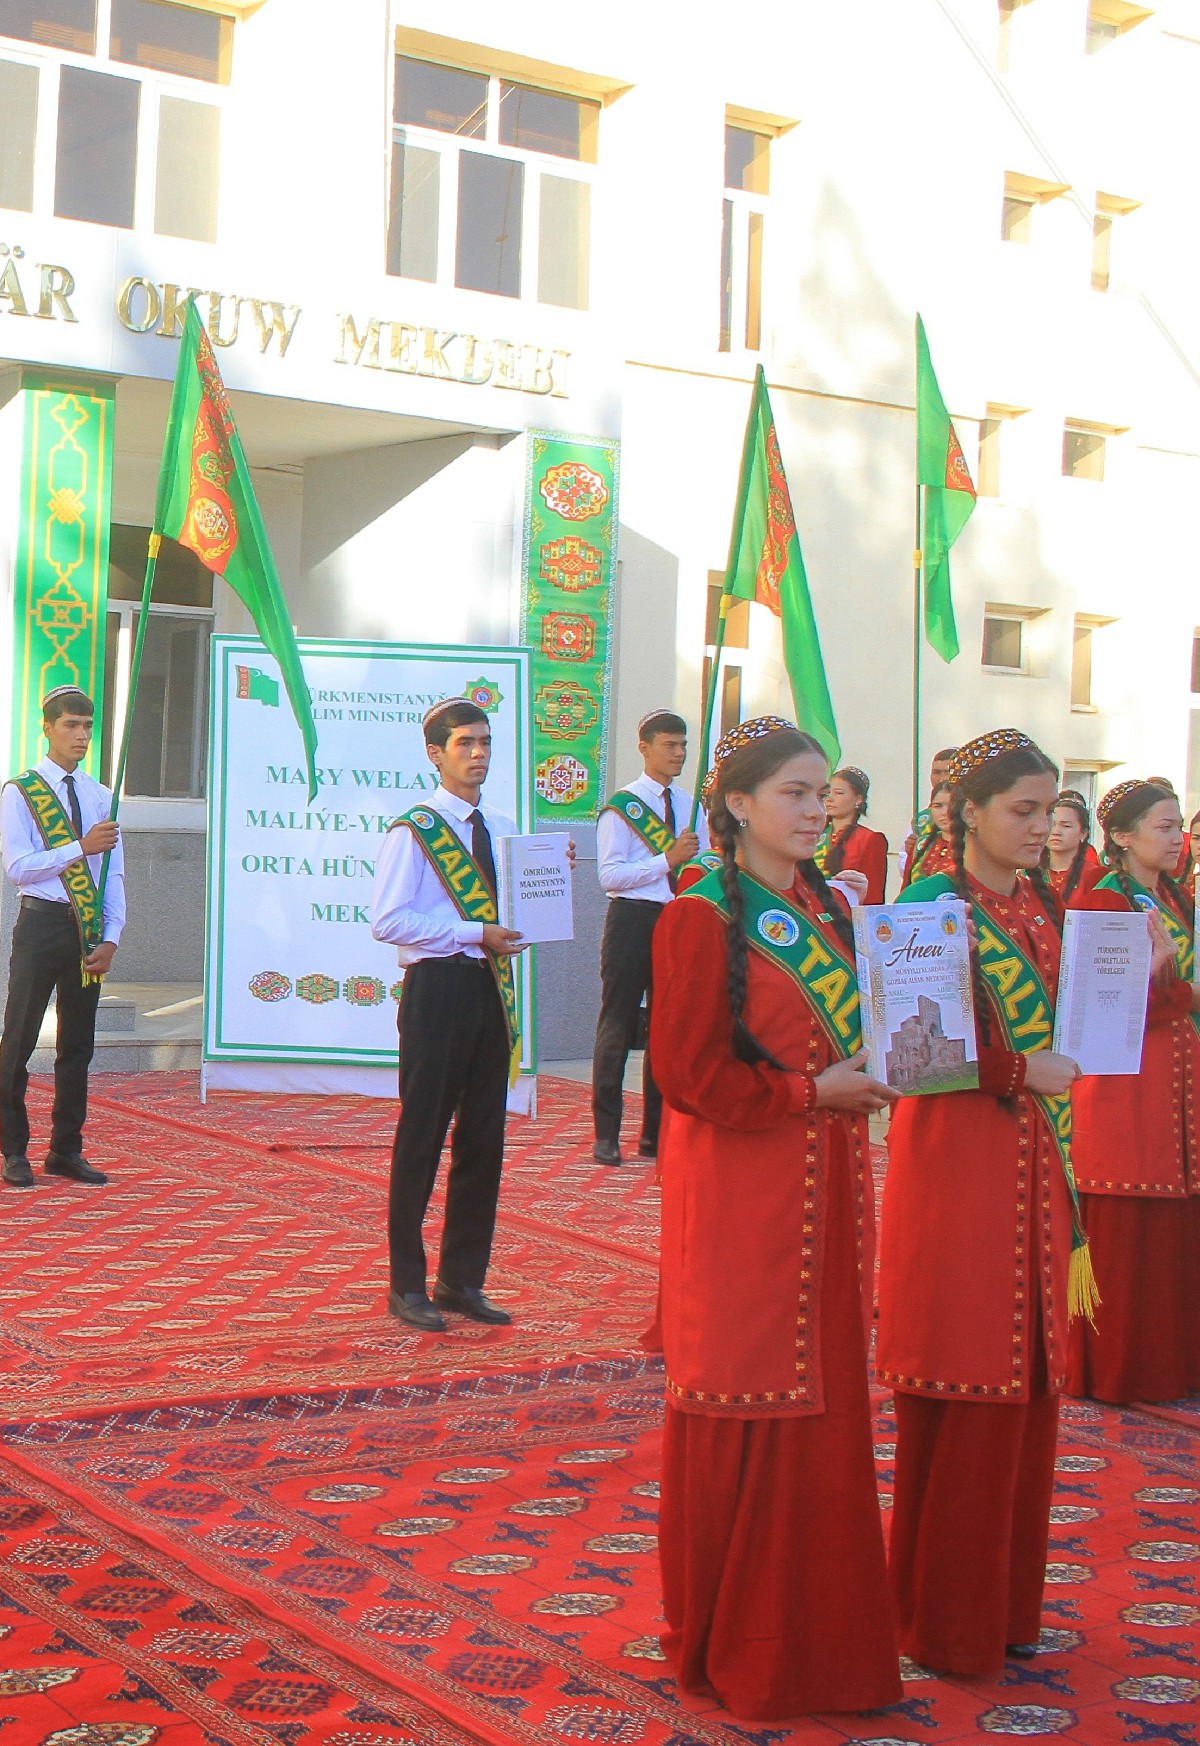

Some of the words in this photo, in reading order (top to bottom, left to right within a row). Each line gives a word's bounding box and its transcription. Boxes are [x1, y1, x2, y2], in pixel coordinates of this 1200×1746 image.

[116, 276, 302, 358] OKUW
[332, 311, 573, 399] MEKDEBI
[312, 708, 343, 721] LIM
[348, 708, 423, 724] MINISTRL
[266, 765, 344, 786] MARY
[246, 808, 397, 834] MALIÝE-YK
[241, 854, 315, 876] ORTA
[322, 855, 377, 878] HÜN
[430, 826, 498, 924] TALYP
[521, 889, 565, 900] DOWAMATY
[885, 928, 947, 967] Änew
